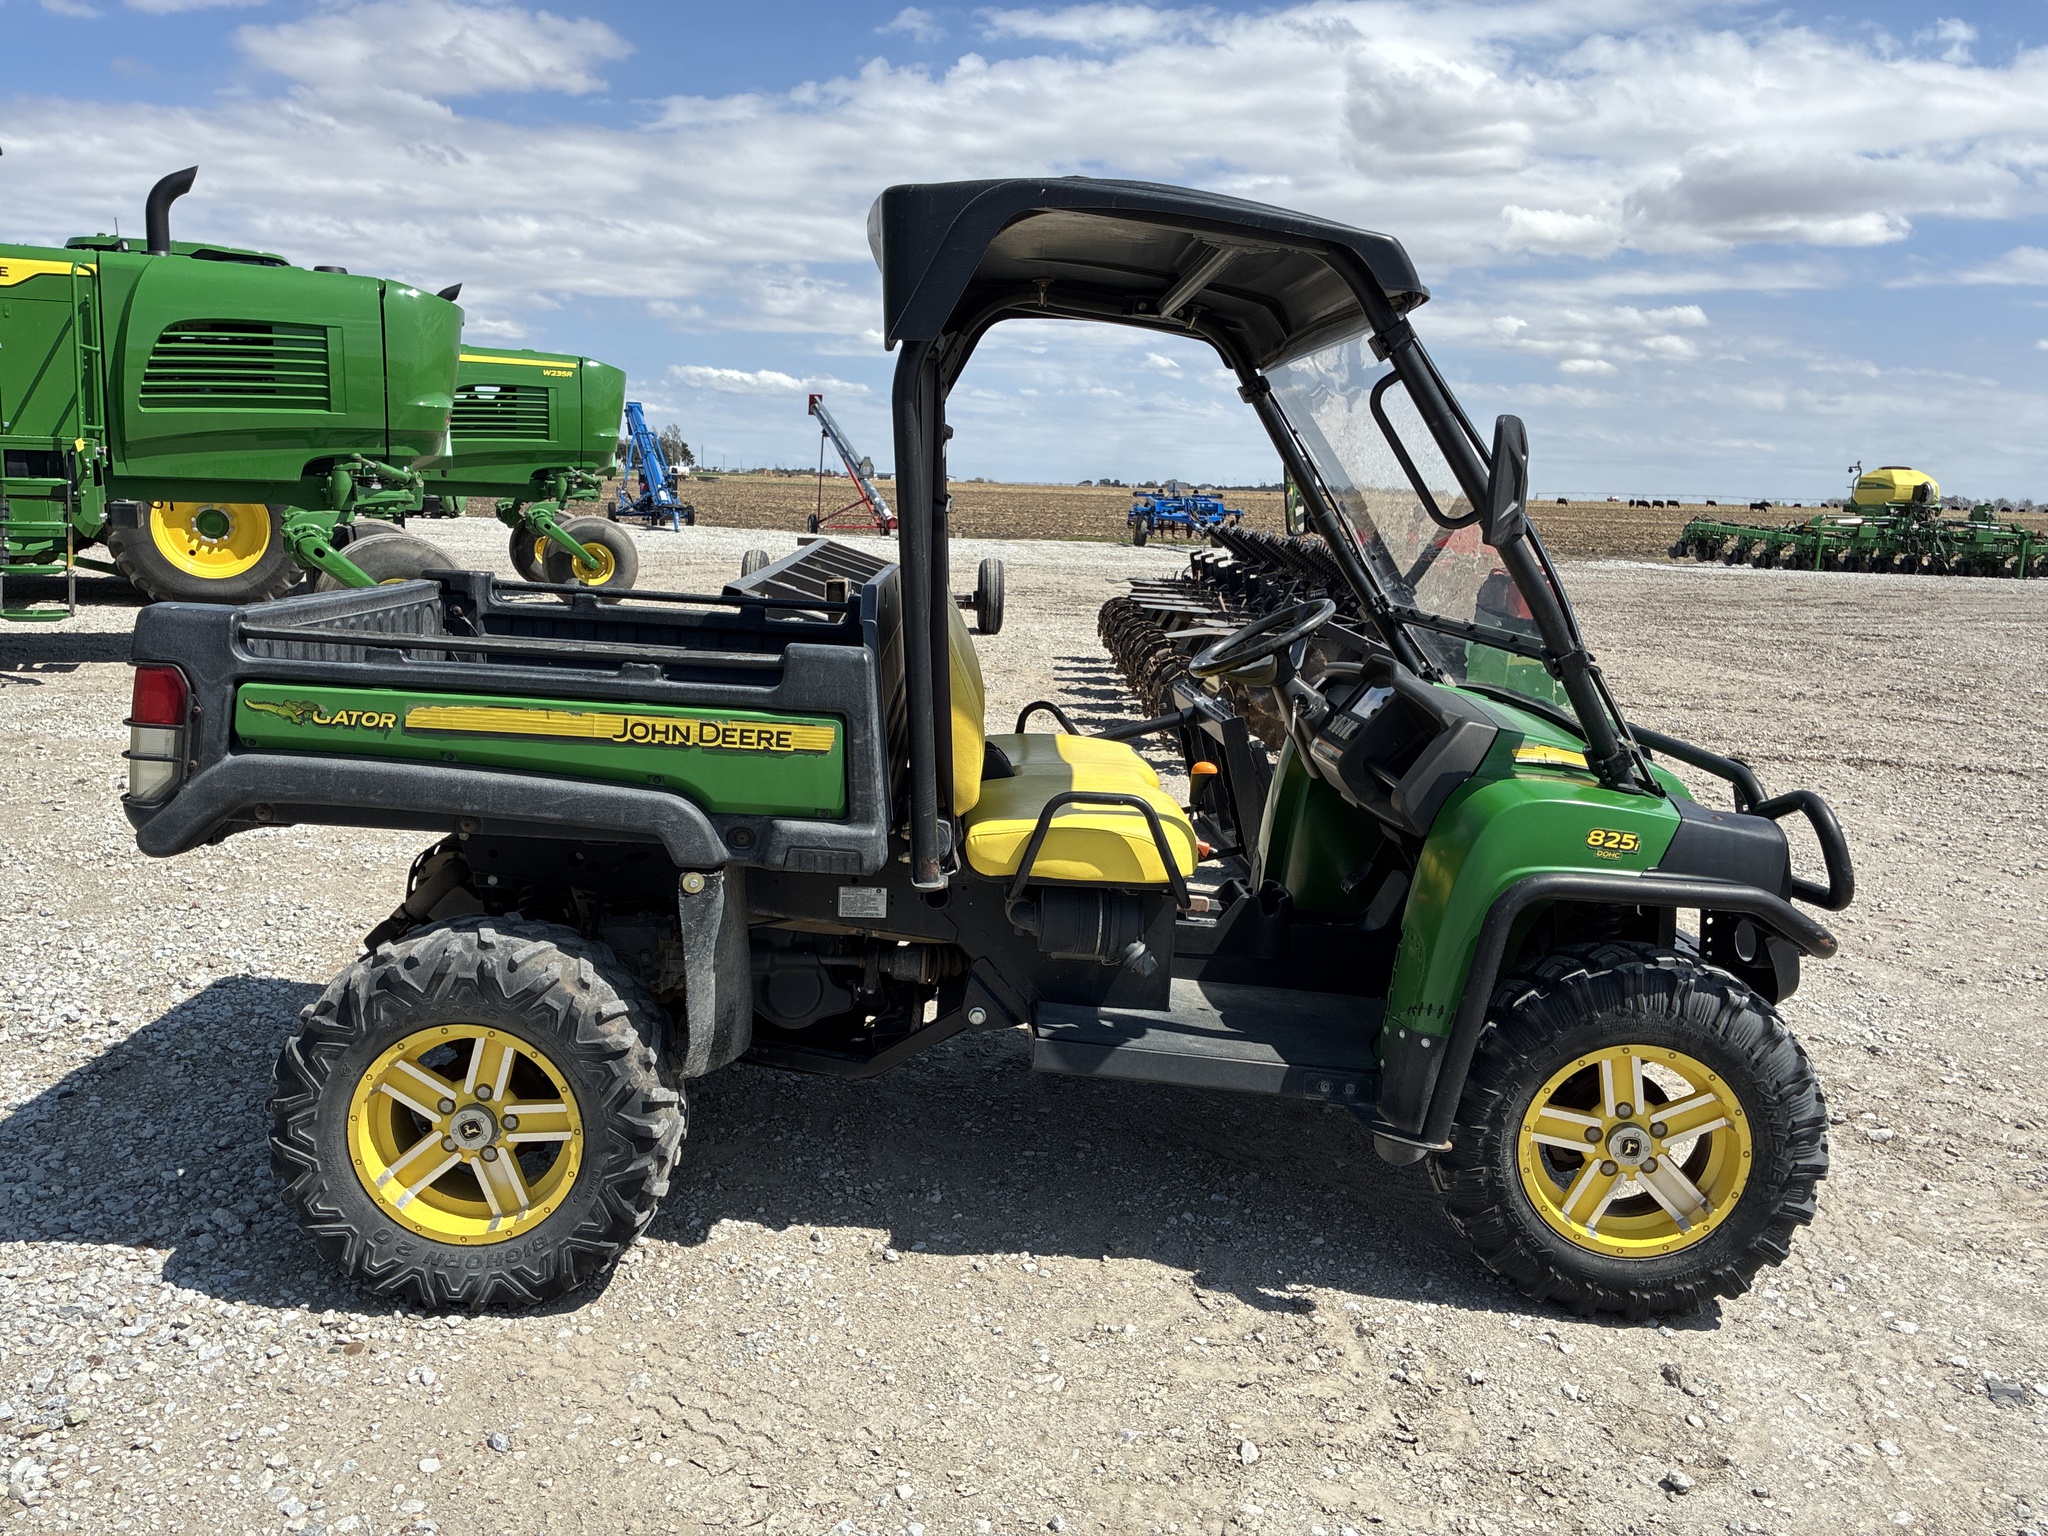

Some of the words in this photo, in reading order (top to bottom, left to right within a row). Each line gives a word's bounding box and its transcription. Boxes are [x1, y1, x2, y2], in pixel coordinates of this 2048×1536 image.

[543, 369, 573, 378] W235R
[612, 717, 692, 743] JOHN
[698, 722, 793, 749] DEERE
[1587, 829, 1641, 851] 825i
[1596, 850, 1621, 859] DOHC
[374, 1228, 419, 1257] 2.0
[421, 1231, 552, 1271] BIGHORN
